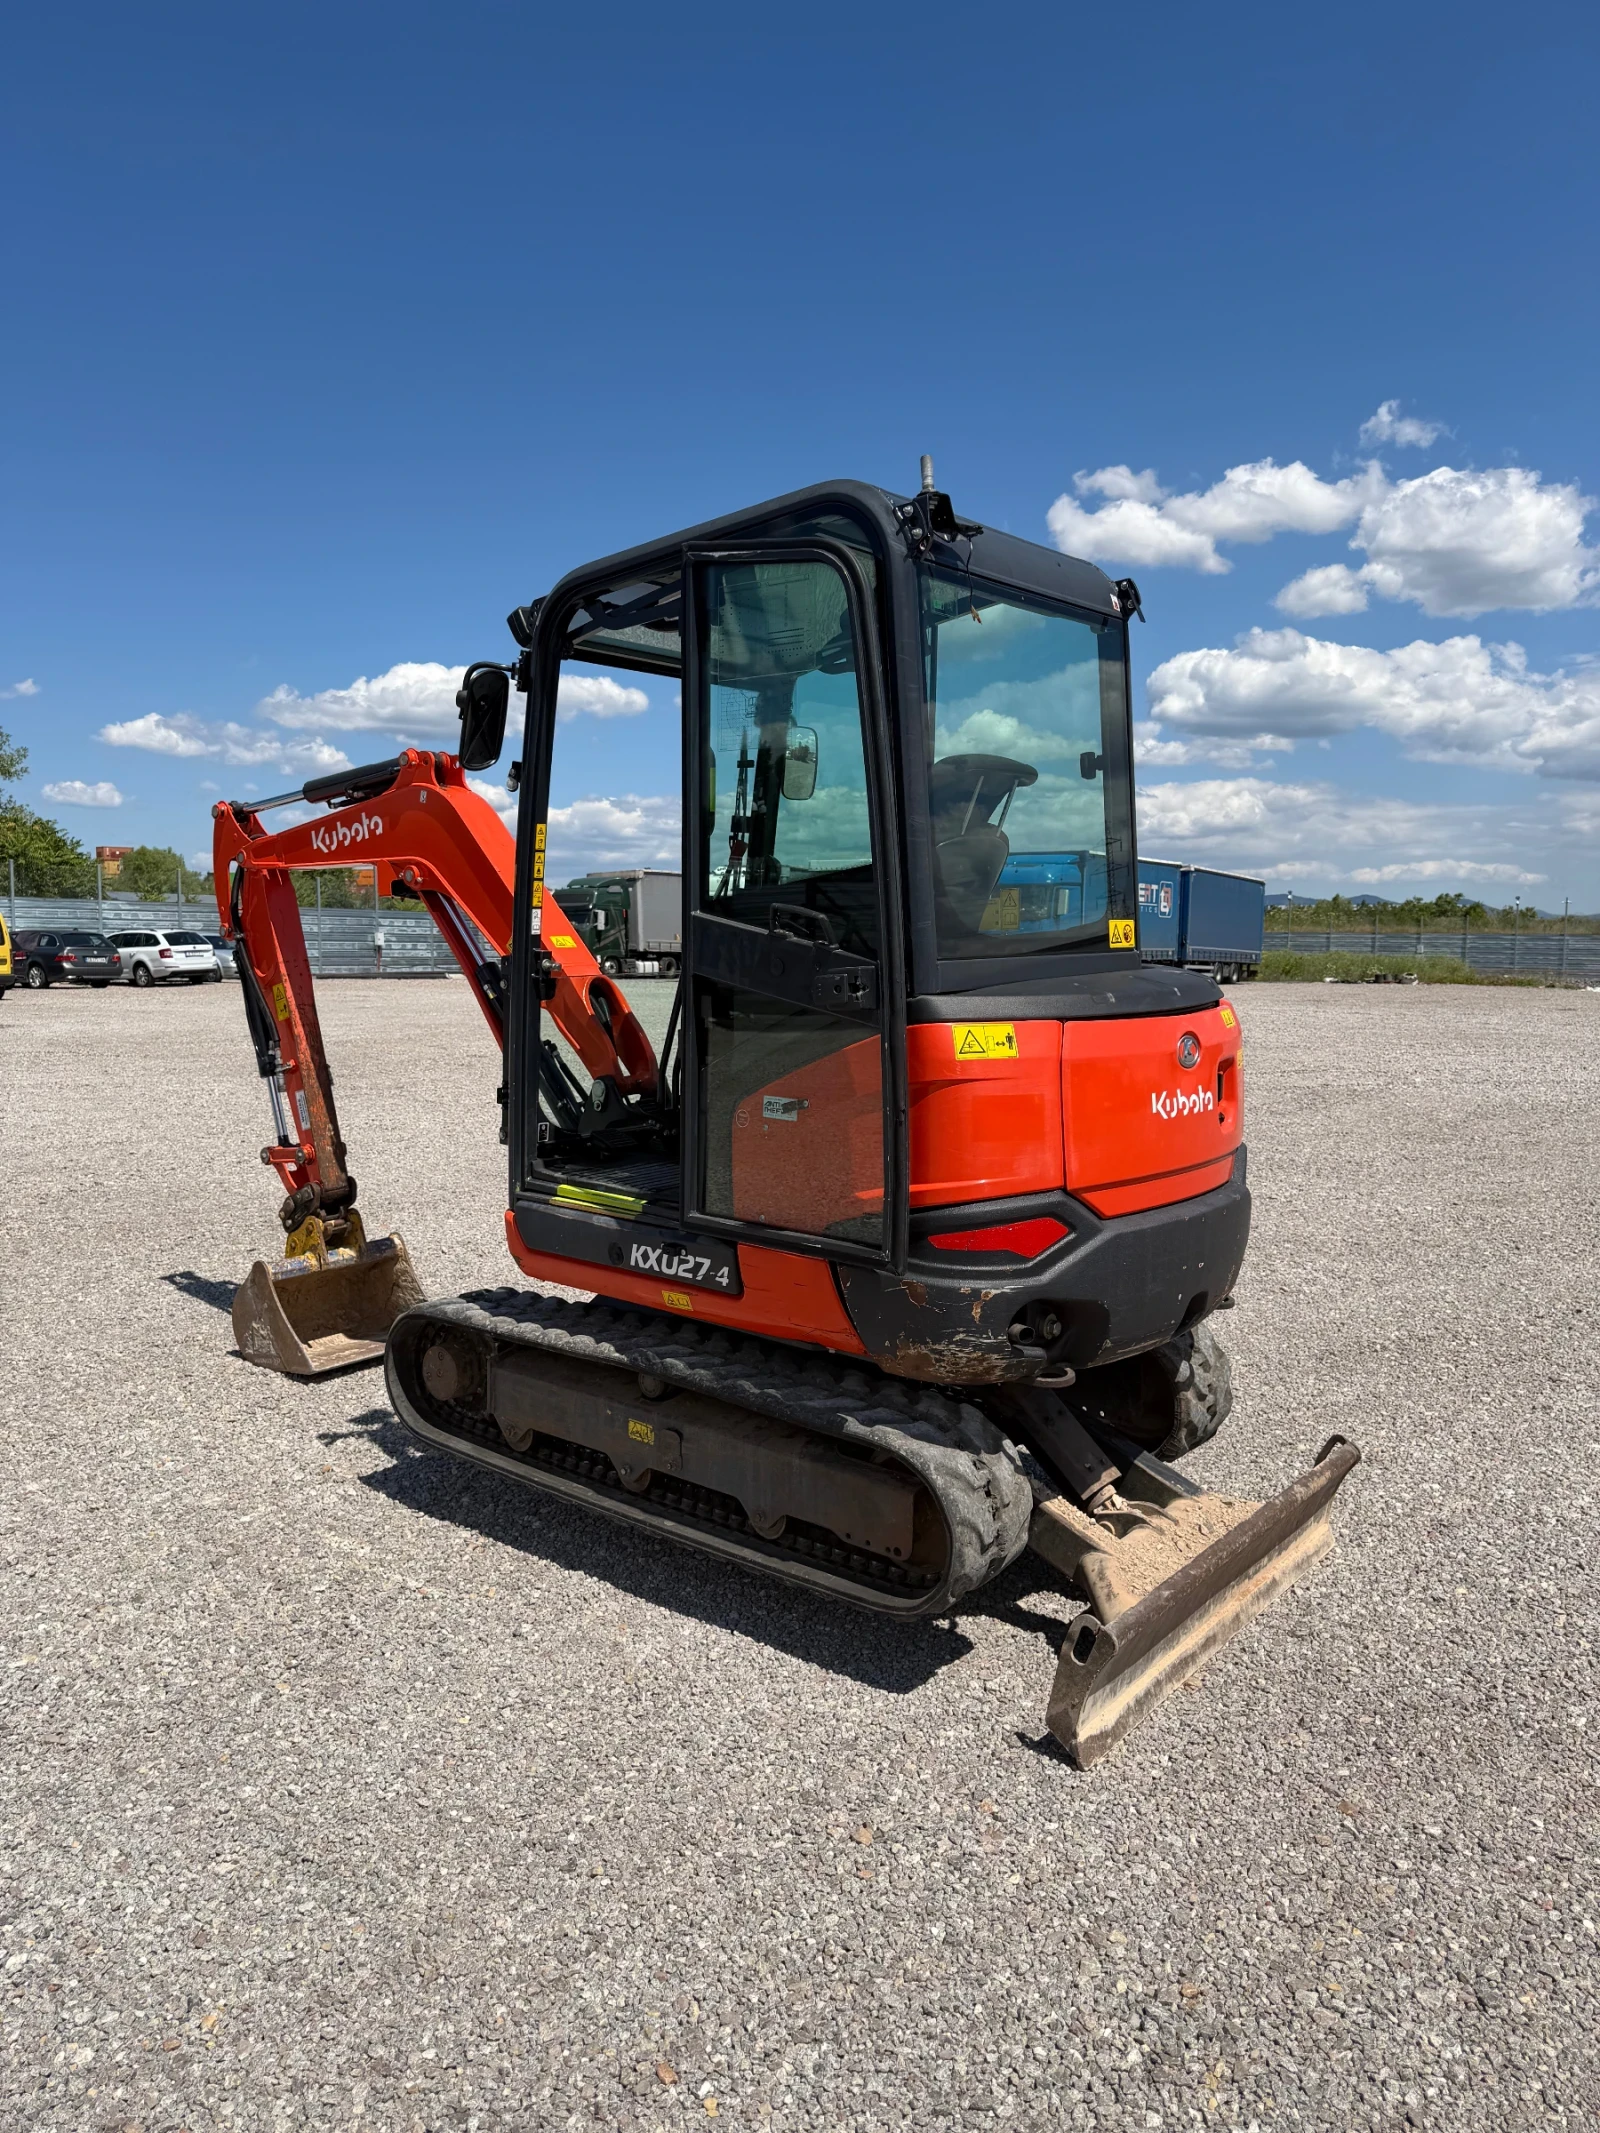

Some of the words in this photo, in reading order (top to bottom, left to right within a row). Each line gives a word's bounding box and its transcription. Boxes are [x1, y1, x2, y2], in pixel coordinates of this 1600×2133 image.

[311, 812, 383, 853] Kubota
[764, 1106, 784, 1115] THEF
[1151, 1085, 1213, 1120] Kubota
